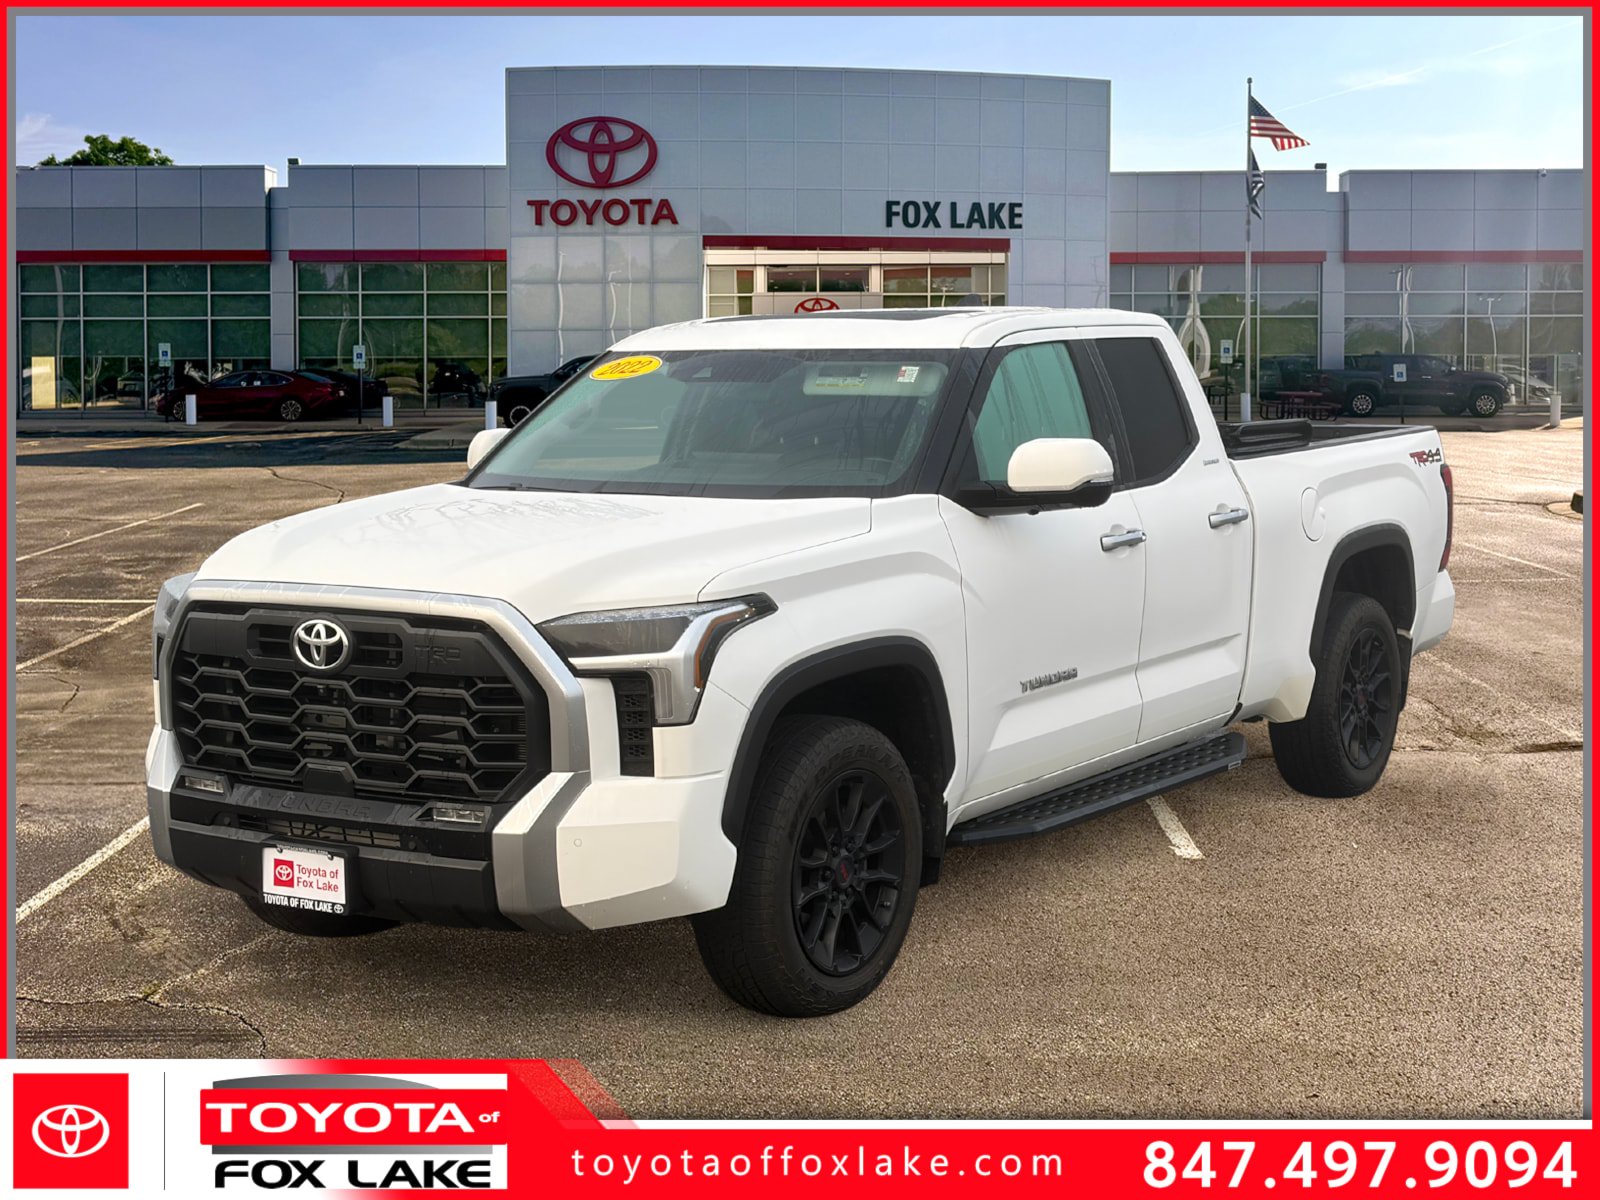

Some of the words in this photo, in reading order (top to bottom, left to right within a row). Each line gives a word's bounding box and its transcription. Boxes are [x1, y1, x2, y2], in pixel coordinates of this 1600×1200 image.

[527, 199, 678, 227] TOYOTA
[885, 200, 942, 229] FOX
[950, 201, 1023, 230] LAKE
[596, 360, 654, 376] 2022
[415, 644, 462, 665] TRD
[1020, 667, 1078, 693] TUNDRA
[267, 792, 371, 819] TUNDRA
[296, 864, 327, 878] Toyota
[329, 869, 339, 879] of
[296, 877, 314, 888] Fox
[316, 880, 339, 892] Lake
[263, 894, 289, 907] TOYOTA
[290, 897, 299, 908] OF
[300, 899, 314, 910] FOX
[315, 901, 334, 913] LAKE
